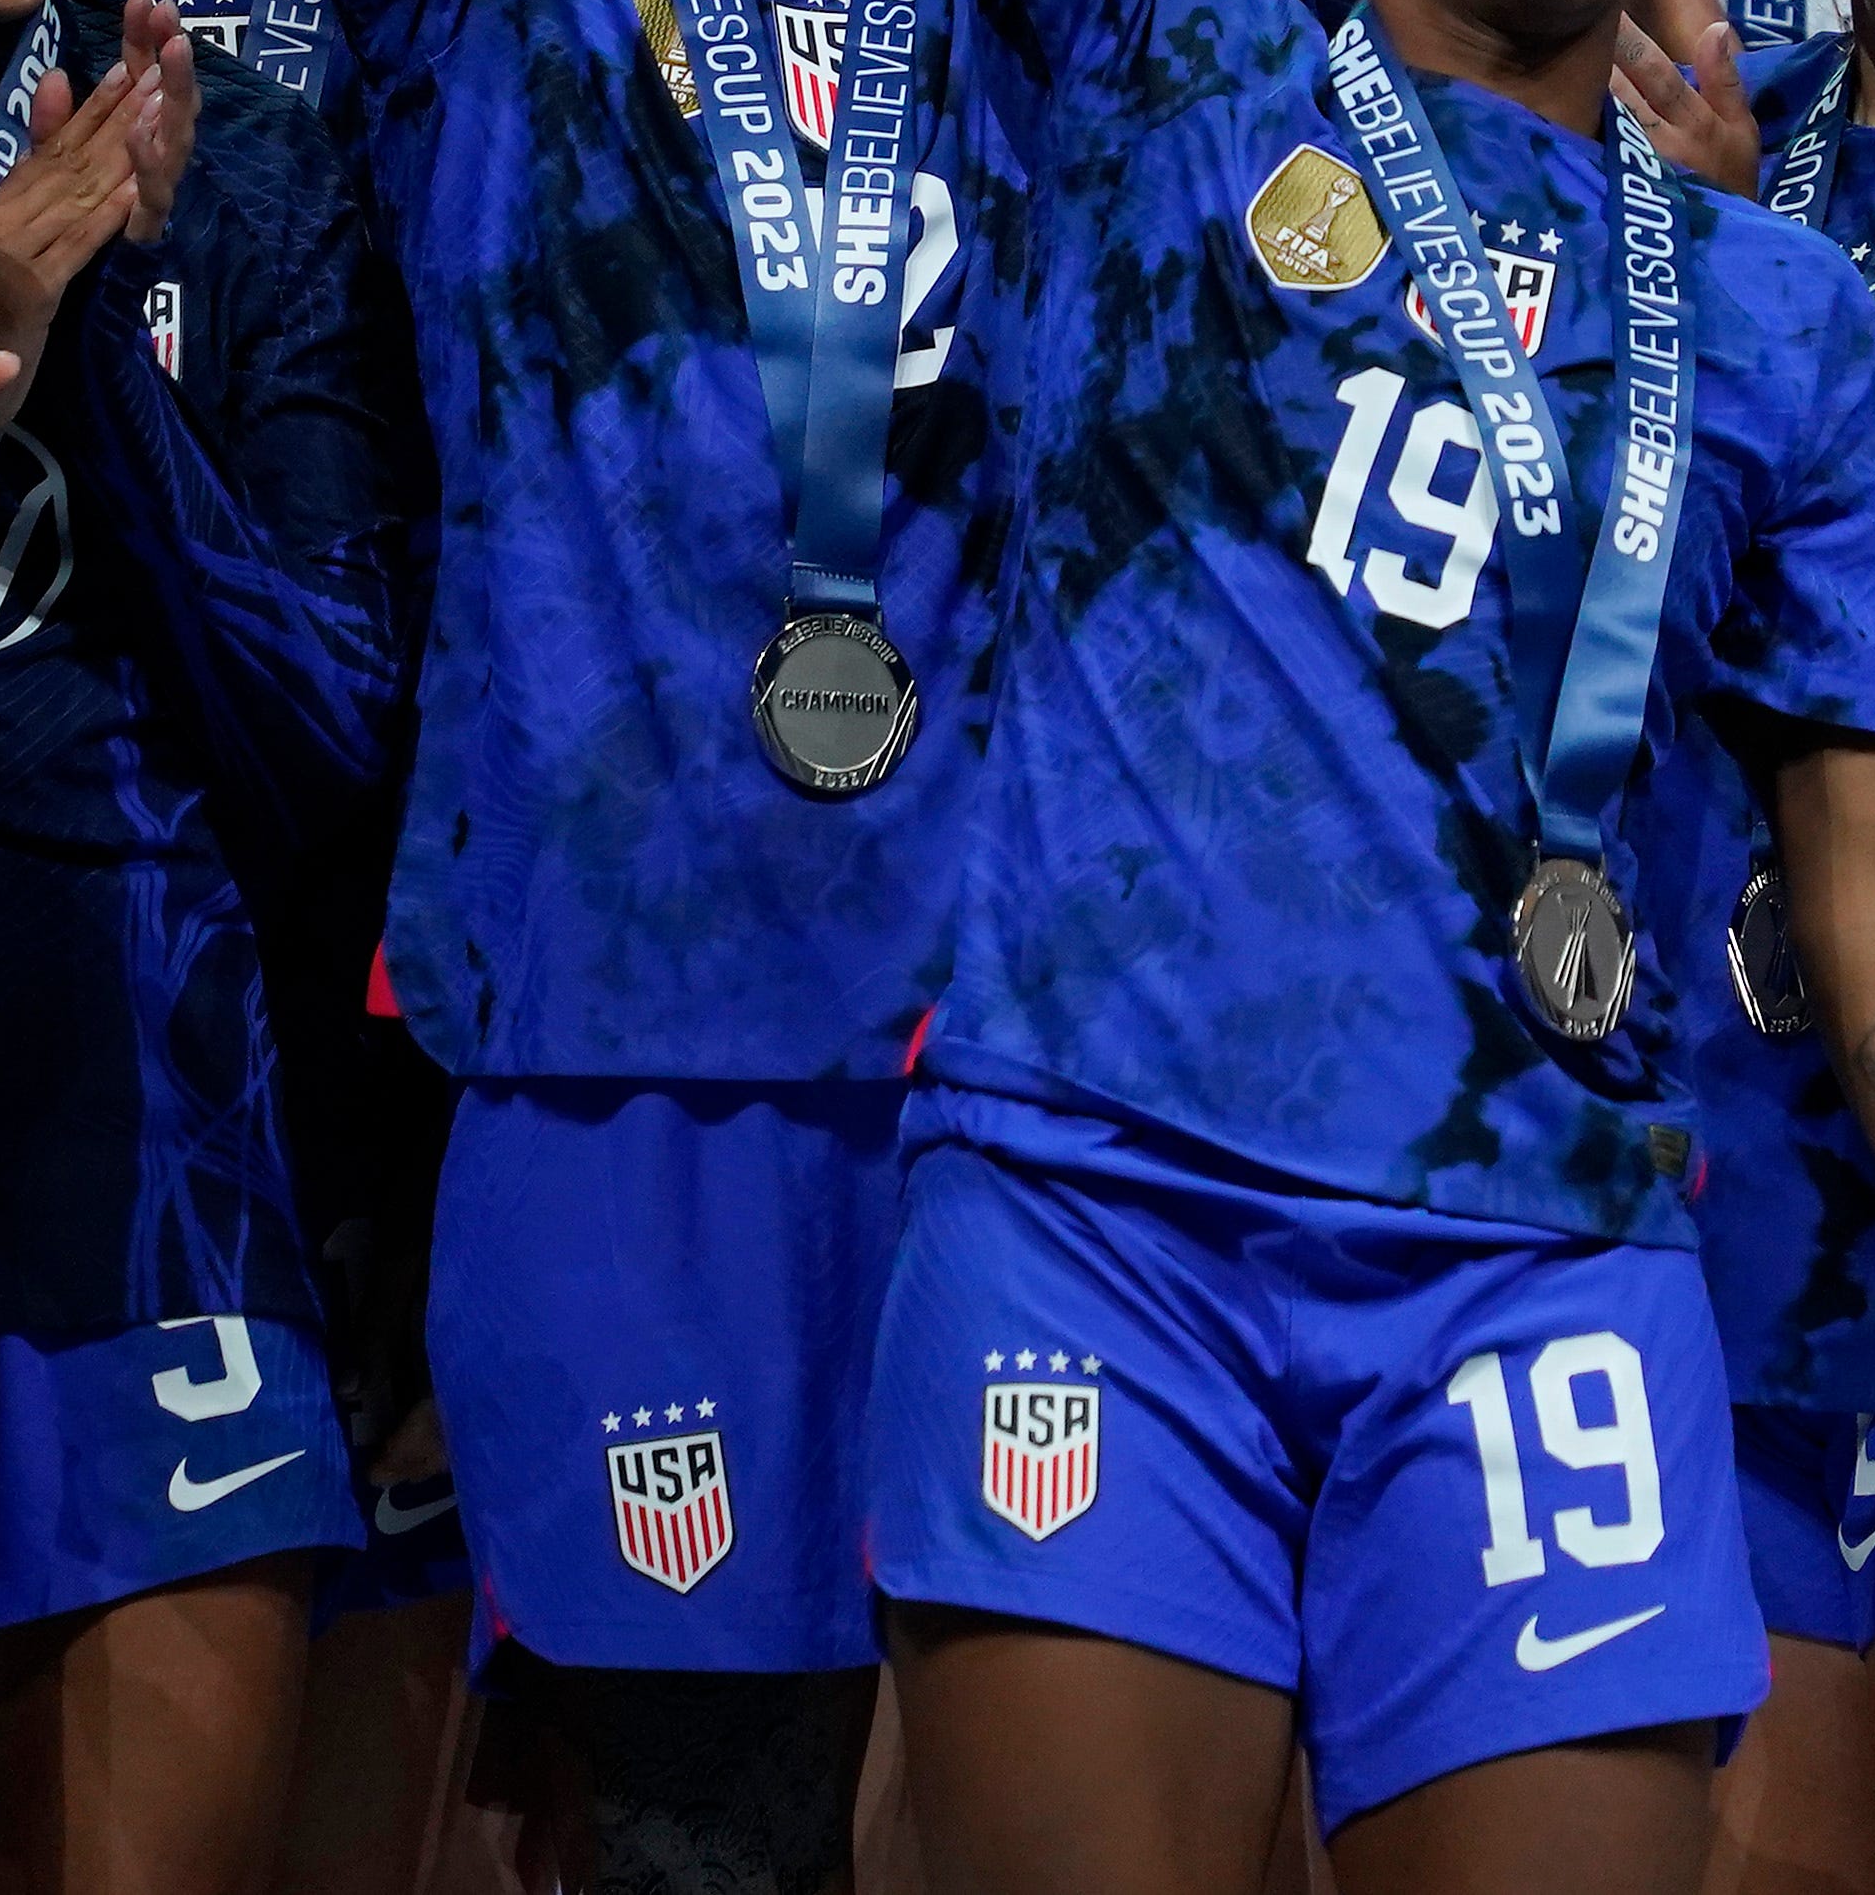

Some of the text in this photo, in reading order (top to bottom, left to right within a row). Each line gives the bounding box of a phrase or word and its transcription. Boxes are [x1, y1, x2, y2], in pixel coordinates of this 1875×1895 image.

[732, 148, 809, 293] 2023
[1275, 226, 1329, 270] FIFA
[1275, 252, 1311, 276] 2019
[1328, 17, 1563, 538] SHEBELIEVESCUP 2023
[1613, 170, 1680, 563] SHEBELIEVESCUP
[1305, 365, 1501, 631] 19
[779, 687, 890, 715] CHAMPION
[993, 1392, 1092, 1447] USA
[1446, 1330, 1666, 1589] 19
[619, 1443, 716, 1504] USA
